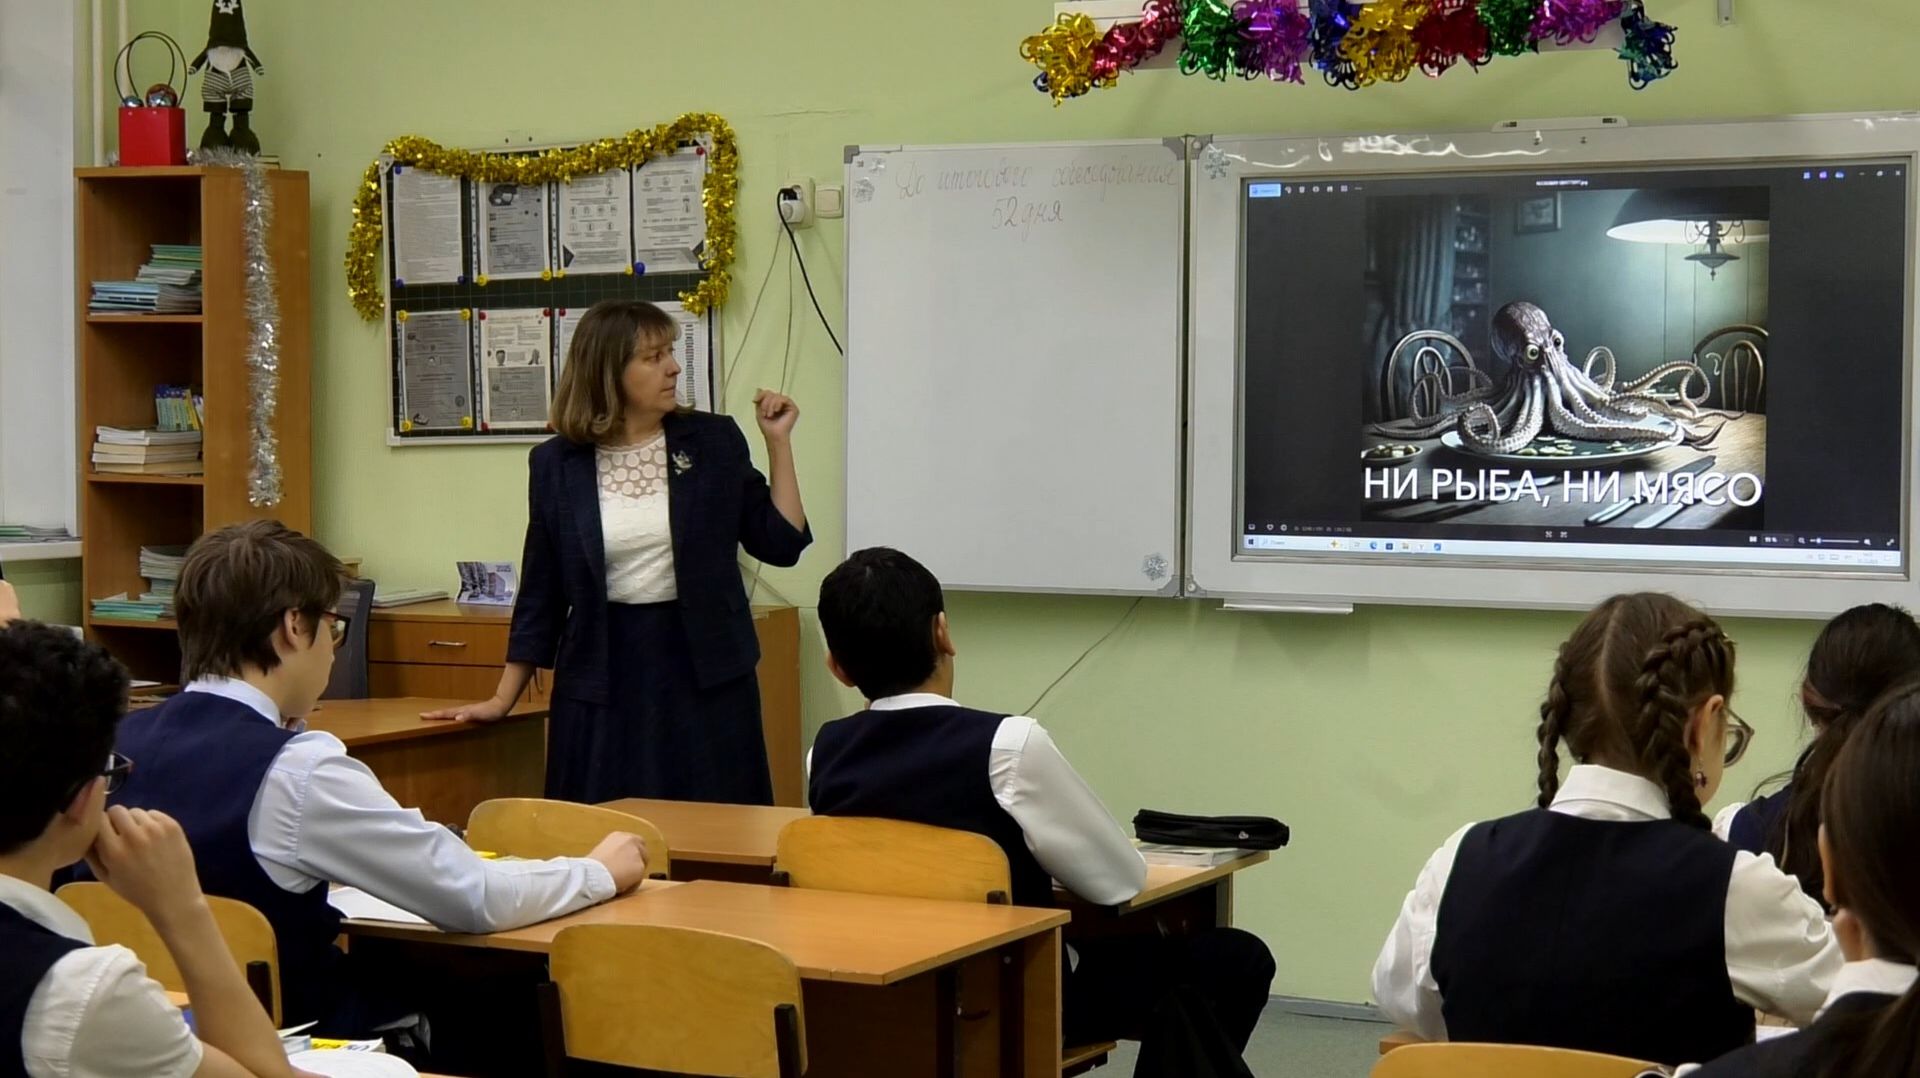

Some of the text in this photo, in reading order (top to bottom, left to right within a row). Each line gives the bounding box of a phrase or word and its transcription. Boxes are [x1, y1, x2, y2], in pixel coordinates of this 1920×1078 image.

[896, 160, 926, 200] До
[1364, 467, 1763, 508] НИ РЫБА, НИ МЯСО
